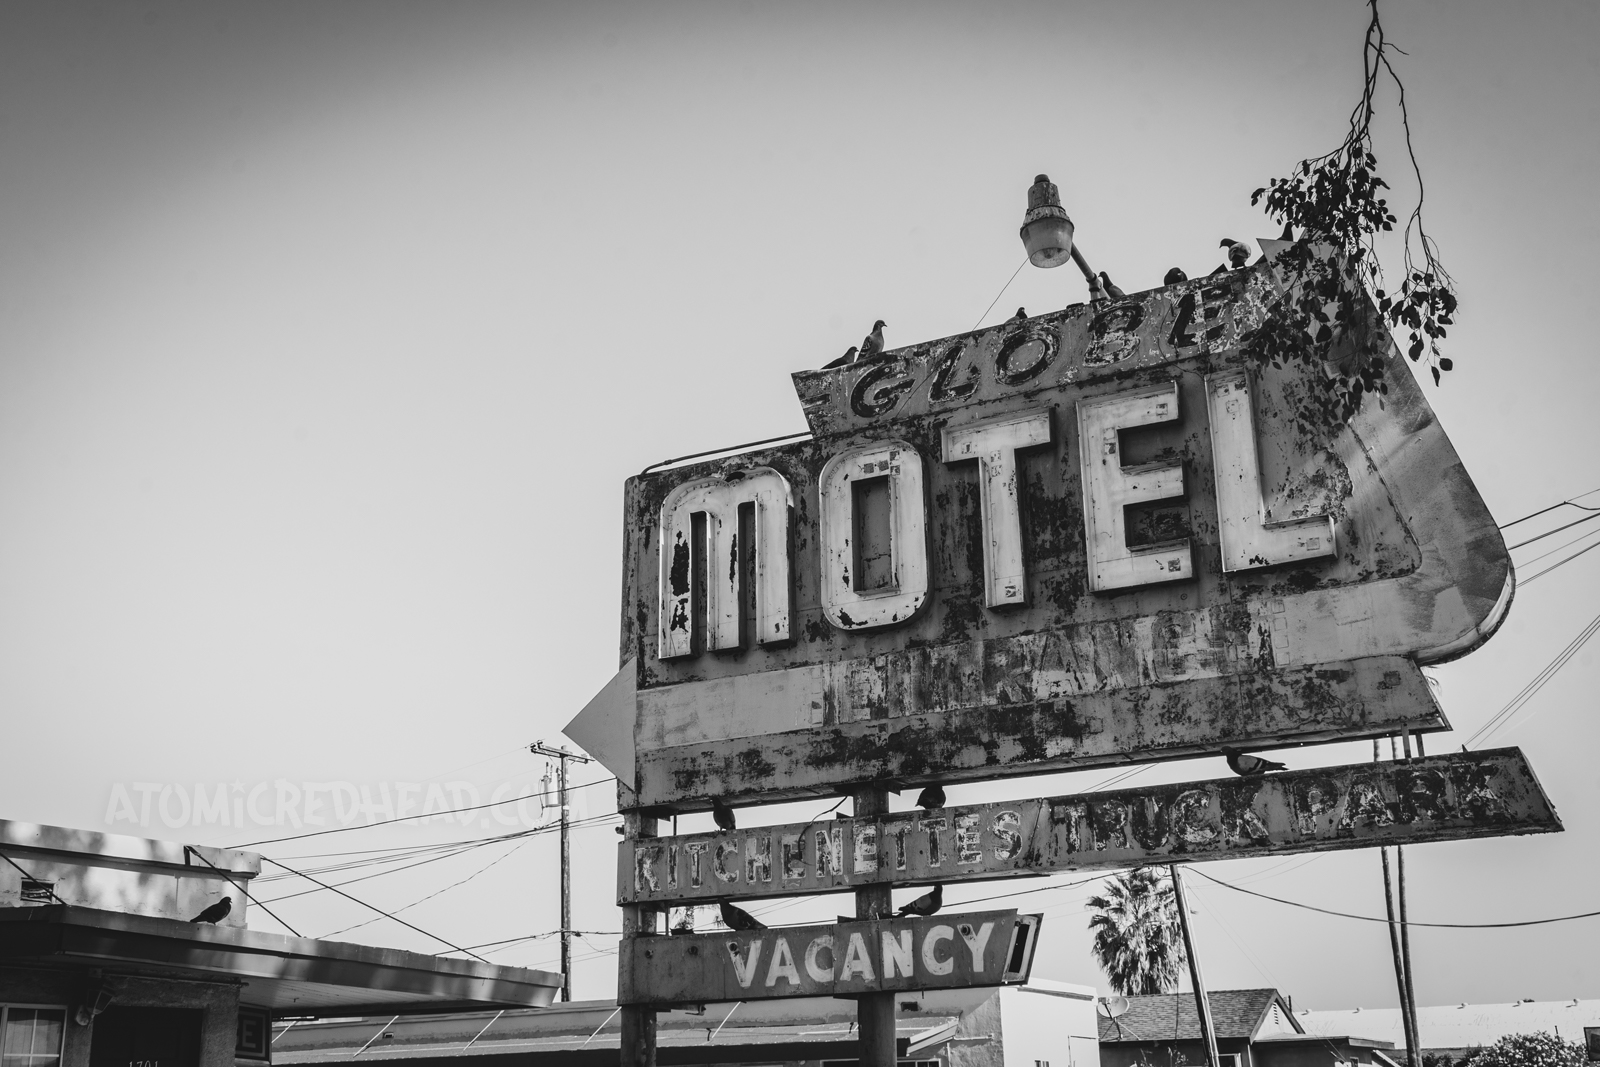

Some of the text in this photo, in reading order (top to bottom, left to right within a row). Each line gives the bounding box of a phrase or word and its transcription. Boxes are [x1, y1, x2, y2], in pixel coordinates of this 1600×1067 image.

[851, 286, 1232, 418] GLOBE
[658, 371, 1337, 660] MOTEL
[634, 762, 1512, 892] KITCHENETTES TRUCK PARK
[726, 922, 994, 989] VACANCY
